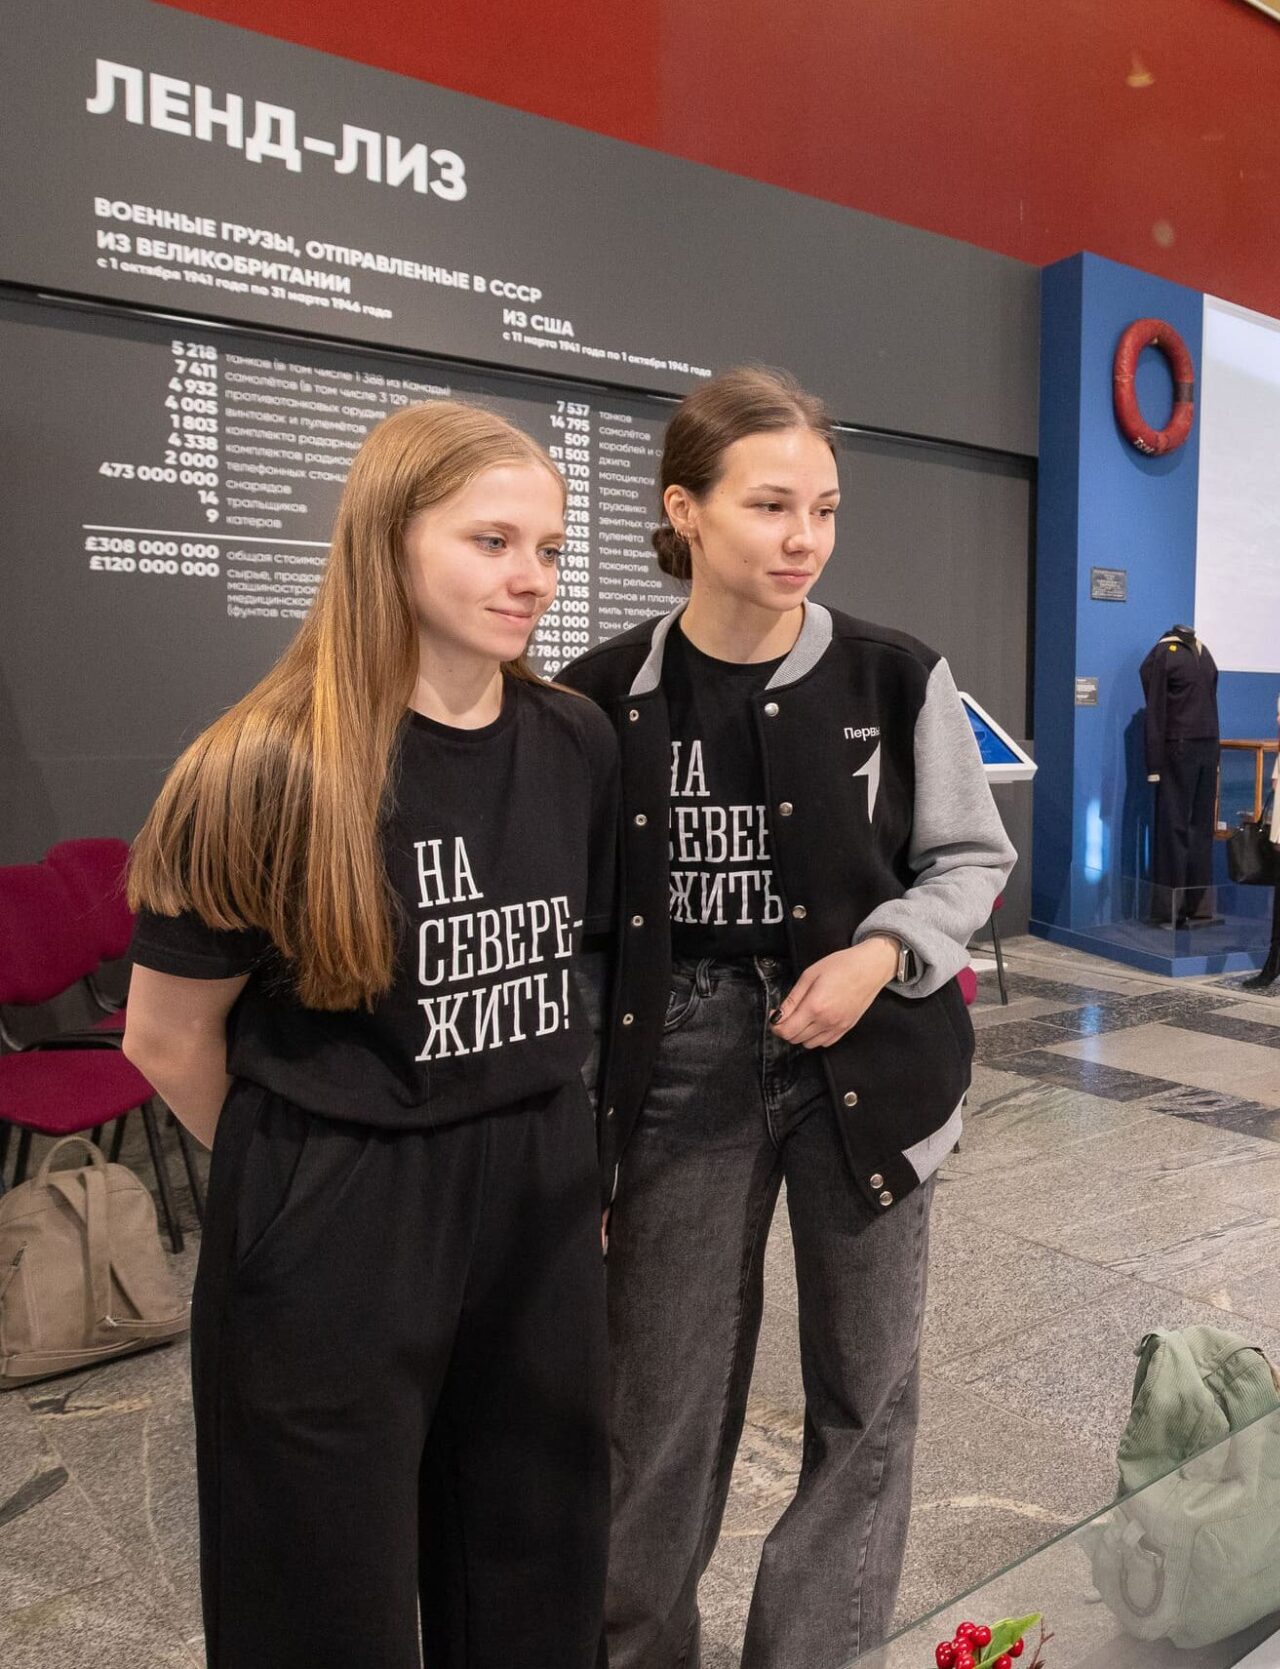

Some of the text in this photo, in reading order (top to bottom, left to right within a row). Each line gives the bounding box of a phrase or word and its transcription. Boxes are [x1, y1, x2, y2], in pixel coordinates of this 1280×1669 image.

[86, 58, 468, 202] ЛЕНД-ЛИЗ
[94, 197, 542, 302] ВОЕННЫЕ ГРУЗЫ, ОТПРАВЛЕННЫЕ В СССР
[96, 230, 351, 294] ИЗ ВЕЛИКОБРИТАНИИ
[96, 257, 392, 318] с 1 октября 1941 года по 31 марта 1946 года
[502, 308, 574, 336] ИЗ США
[171, 340, 184, 355] 5
[186, 342, 218, 360] 218
[225, 354, 272, 369] танков
[288, 363, 312, 375] том
[313, 368, 353, 381] числе
[355, 371, 361, 382] 1
[502, 331, 712, 377] с 11 марта 1941 года по 1 октября 1945 года
[175, 359, 187, 373] 7
[189, 361, 217, 378] 411
[224, 372, 298, 390] самолётов
[314, 384, 338, 395] том
[339, 388, 377, 401] числе
[168, 377, 182, 393] 4
[184, 378, 218, 397] 932
[224, 390, 340, 412] противотанковых
[164, 395, 368, 435] 4 005 винтовок и пулемётов
[557, 400, 632, 423] 7 537 танков
[170, 414, 180, 428] 1
[182, 415, 218, 433] 803
[225, 426, 296, 442] комплекта
[550, 414, 651, 440] 14 795 самолётов
[168, 432, 182, 446] 4
[183, 433, 218, 451] 338
[225, 444, 303, 460] комплектов
[548, 445, 630, 467] 51 503 джипа
[564, 432, 590, 446] 509
[598, 442, 646, 454] кораблей
[164, 449, 177, 464] 2
[179, 451, 218, 469] 000
[226, 461, 306, 477] телефонных
[567, 463, 590, 477] 170
[99, 462, 292, 494] 473 000 000 снарядов
[567, 478, 639, 499] 701 трактор
[198, 489, 308, 513] 14 тральщиков
[598, 501, 646, 513] грузовика
[206, 508, 282, 528] 9 катеров
[567, 509, 590, 523] 218
[598, 516, 642, 527] зенитных
[564, 524, 644, 542] 633 пулемёта
[85, 536, 136, 553] £308
[138, 540, 178, 556] 000
[180, 542, 220, 559] 000
[226, 550, 272, 562] общая
[566, 539, 590, 553] 735
[598, 546, 622, 555] тонн
[89, 555, 136, 572] £120
[138, 558, 179, 574] 000
[180, 561, 220, 577] 000
[559, 554, 649, 572] 1 981 локомотив
[561, 569, 590, 583] 000
[598, 576, 622, 584] тонн
[622, 578, 662, 588] рельсов
[567, 585, 589, 598] 155
[598, 591, 638, 601] вагонов
[227, 603, 279, 618] (фунтов
[561, 600, 589, 613] 000
[598, 606, 622, 615] миль
[561, 615, 589, 628] 000
[598, 621, 621, 629] тонн
[561, 630, 589, 643] 000
[533, 644, 560, 657] 786
[669, 805, 771, 863] ЕВЕ
[413, 836, 484, 908] НА
[669, 870, 784, 926] ЖИТЬ
[418, 895, 583, 986] СЕВЕРЕ-
[415, 969, 569, 1062] ЖИТЬ!
